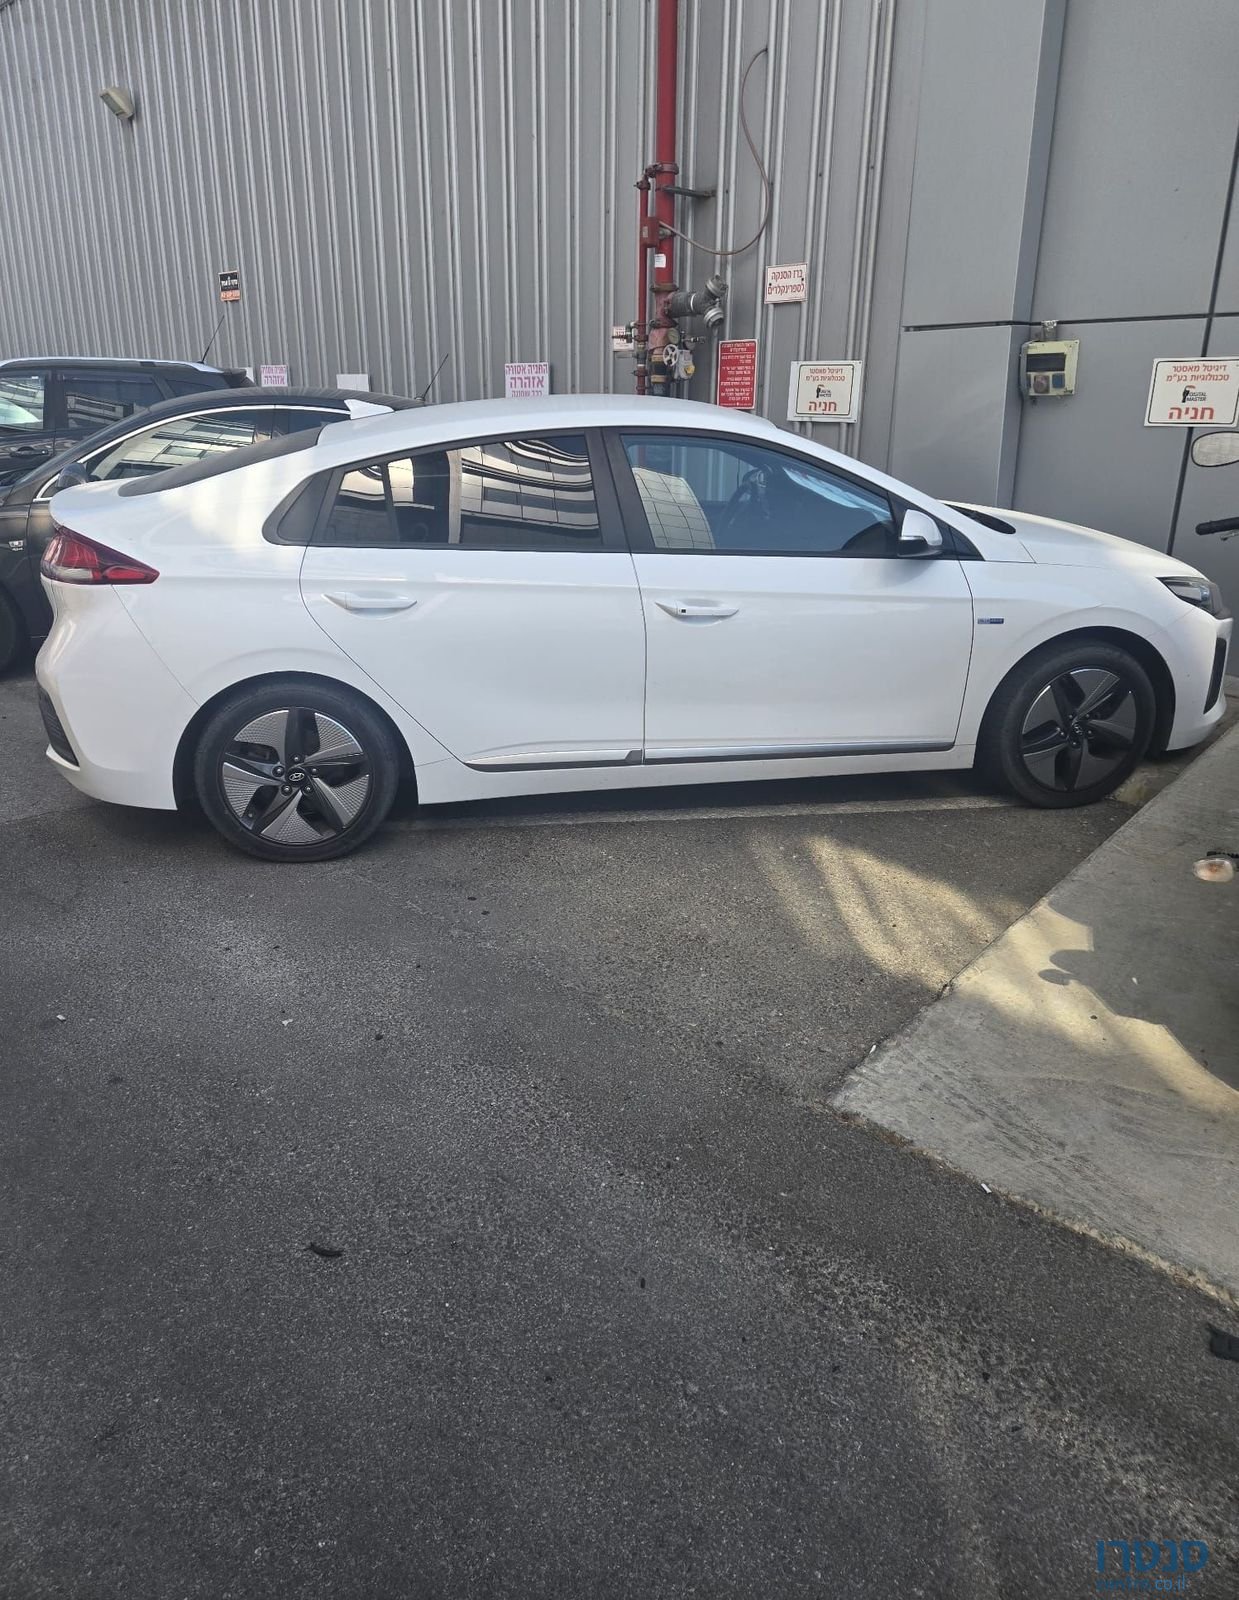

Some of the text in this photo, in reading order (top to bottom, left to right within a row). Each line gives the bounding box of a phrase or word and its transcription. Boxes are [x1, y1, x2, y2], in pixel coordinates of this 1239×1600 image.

[1172, 363, 1228, 373] דיגיטל מאסטר
[510, 376, 545, 389] אזהרה
[808, 401, 837, 412] חניה
[1168, 406, 1215, 420] חניה
